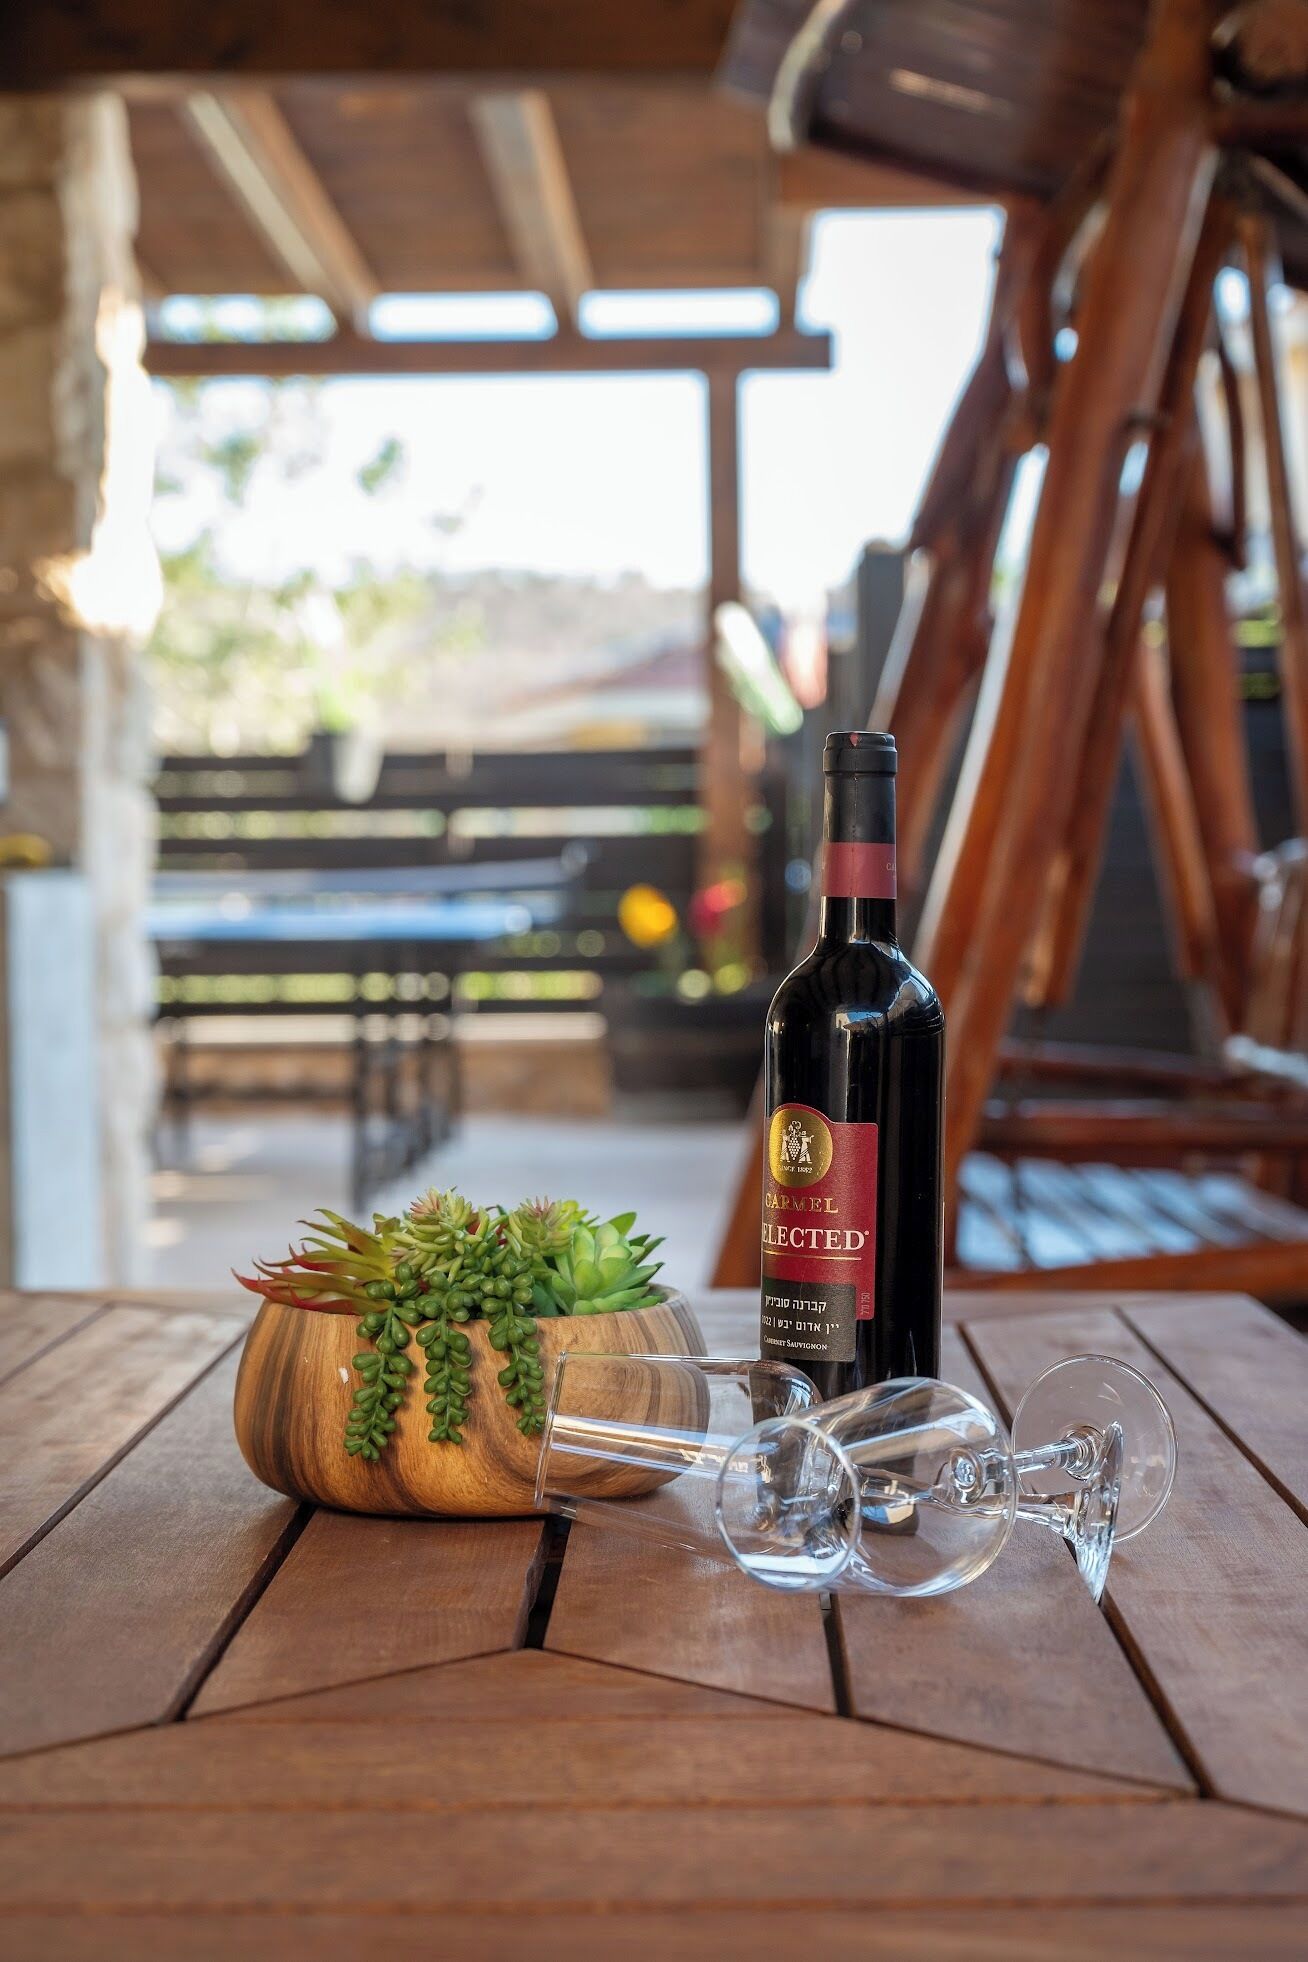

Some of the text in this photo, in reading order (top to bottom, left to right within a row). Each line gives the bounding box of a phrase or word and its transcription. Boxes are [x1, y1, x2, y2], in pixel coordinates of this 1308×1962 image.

[765, 1193, 839, 1214] CARMEL
[762, 1222, 865, 1250] ELECTED
[792, 1299, 827, 1314] קברנה
[777, 1318, 793, 1329] יבש
[795, 1320, 821, 1332] אדום
[825, 1323, 840, 1335] יין
